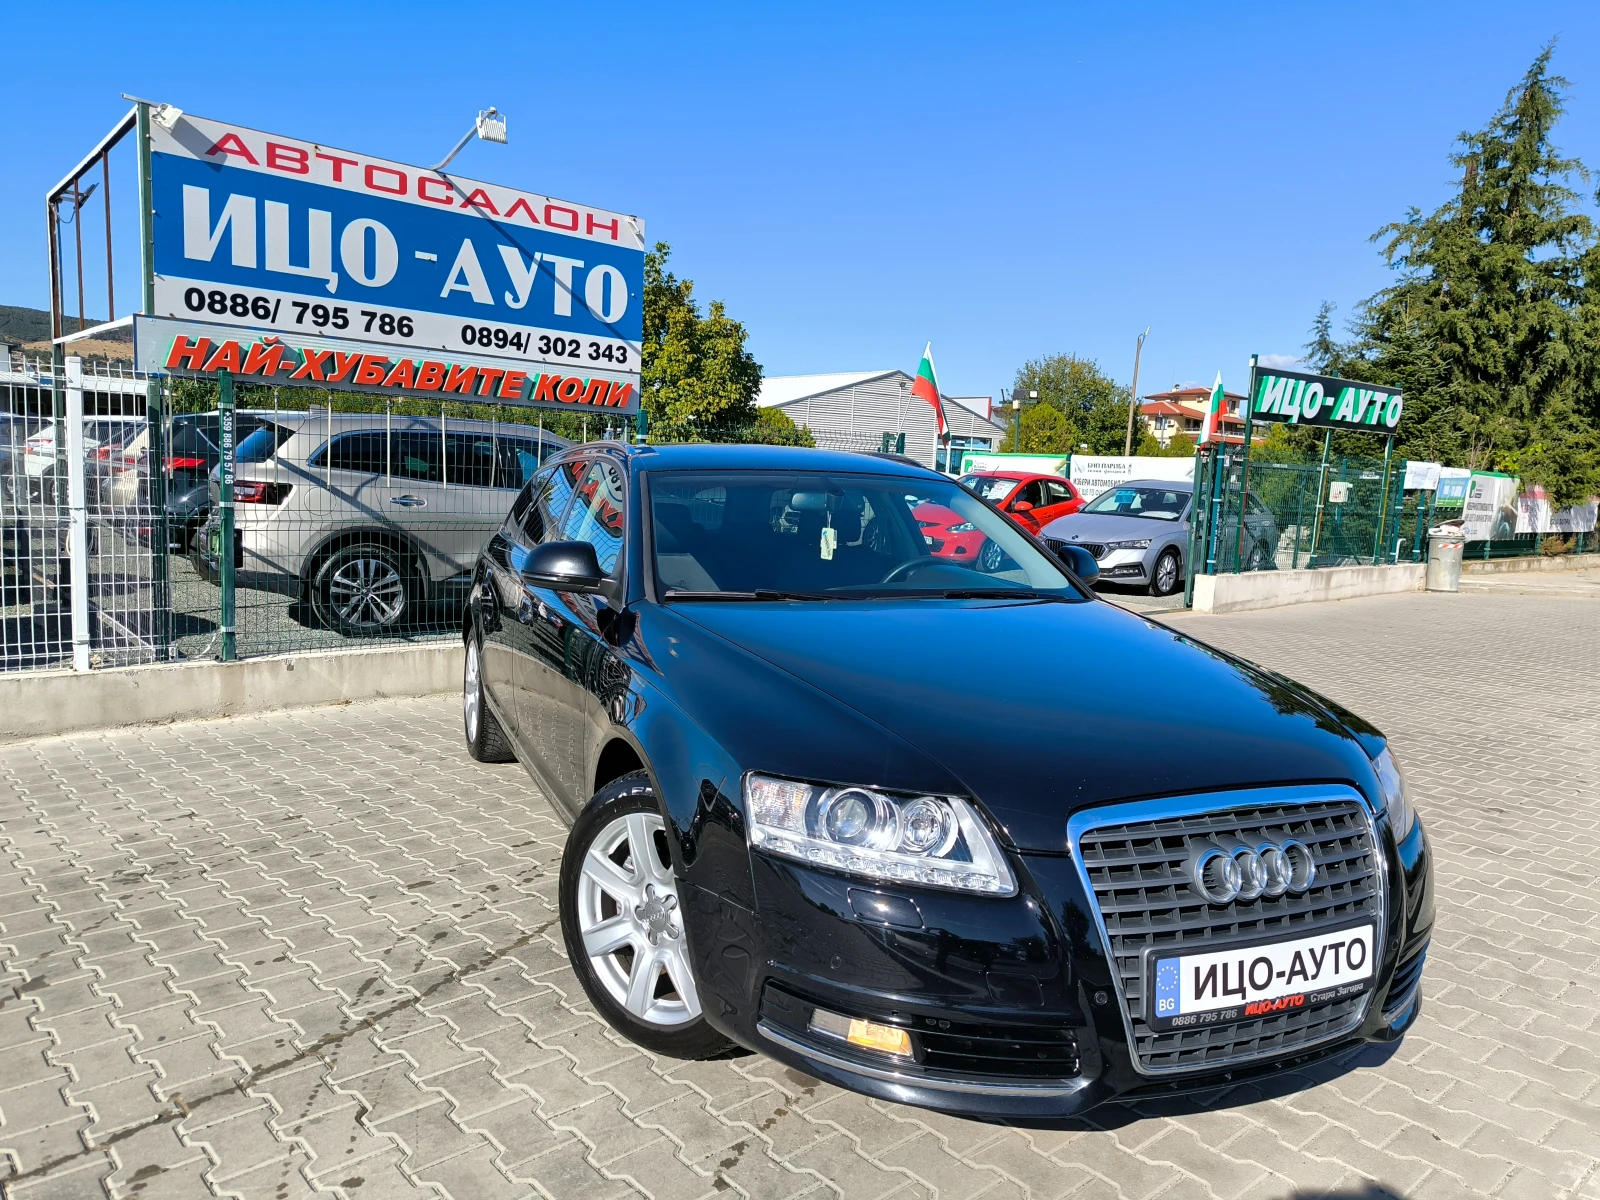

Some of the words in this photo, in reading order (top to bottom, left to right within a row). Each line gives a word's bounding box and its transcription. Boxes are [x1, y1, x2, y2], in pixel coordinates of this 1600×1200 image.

[205, 132, 619, 241] АВТОСАЛОН
[184, 287, 281, 324] 0886/
[292, 300, 350, 330] 795
[361, 310, 414, 338] 786
[461, 324, 530, 354] 0894/
[538, 335, 581, 360] 302
[589, 342, 628, 365] 343
[165, 333, 527, 400] НАЙ-ХУБАВИТЕ
[533, 373, 633, 409] КОЛИ
[1256, 375, 1403, 428] ИЦО-АУТО
[223, 411, 232, 431] +359
[223, 433, 232, 448] 886
[224, 450, 233, 460] 79
[224, 462, 233, 472] 57
[224, 474, 234, 485] 86
[1194, 937, 1367, 1000] ИЦО-АУТО
[1159, 999, 1175, 1012] BG
[1172, 1015, 1197, 1026] 0886
[1200, 1012, 1218, 1023] 795
[1220, 1009, 1238, 1020] 786
[1245, 994, 1305, 1016] ИЦО-АУТО
[1310, 990, 1336, 1003] Стара
[1337, 983, 1364, 997] Загора
